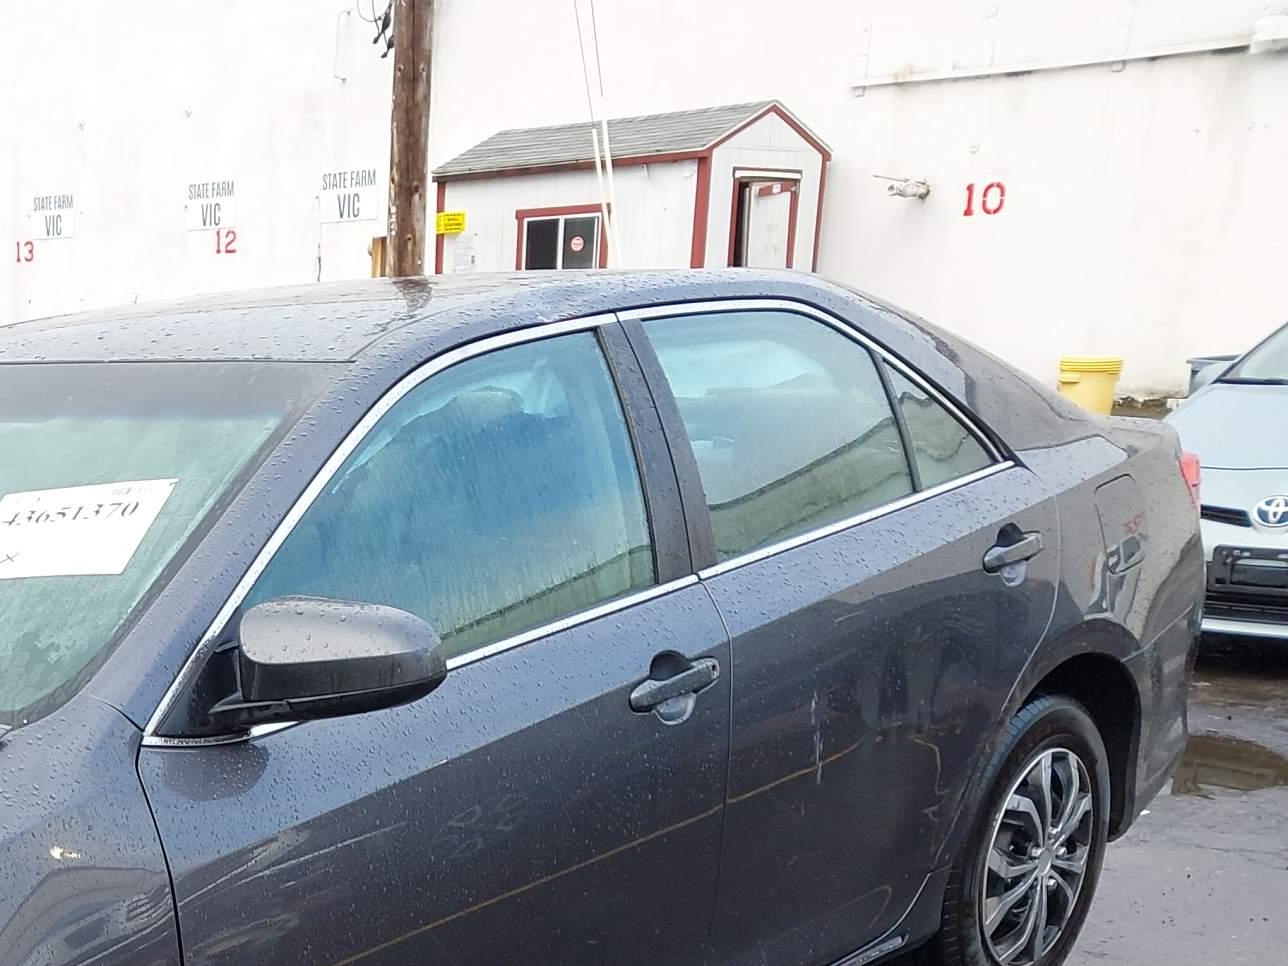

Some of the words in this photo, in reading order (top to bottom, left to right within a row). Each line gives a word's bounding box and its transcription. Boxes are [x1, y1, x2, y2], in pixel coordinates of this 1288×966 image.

[188, 183, 210, 200] STATE
[211, 180, 235, 199] FARM
[322, 171, 349, 190] STATE
[350, 168, 377, 188] FARM
[33, 196, 53, 212] STATE
[53, 193, 74, 211] FARM
[337, 193, 360, 218] VIC
[963, 181, 1006, 217] 10
[44, 214, 63, 237] VIC
[201, 203, 221, 226] VIC
[15, 240, 35, 263] 13
[215, 229, 238, 254] 12
